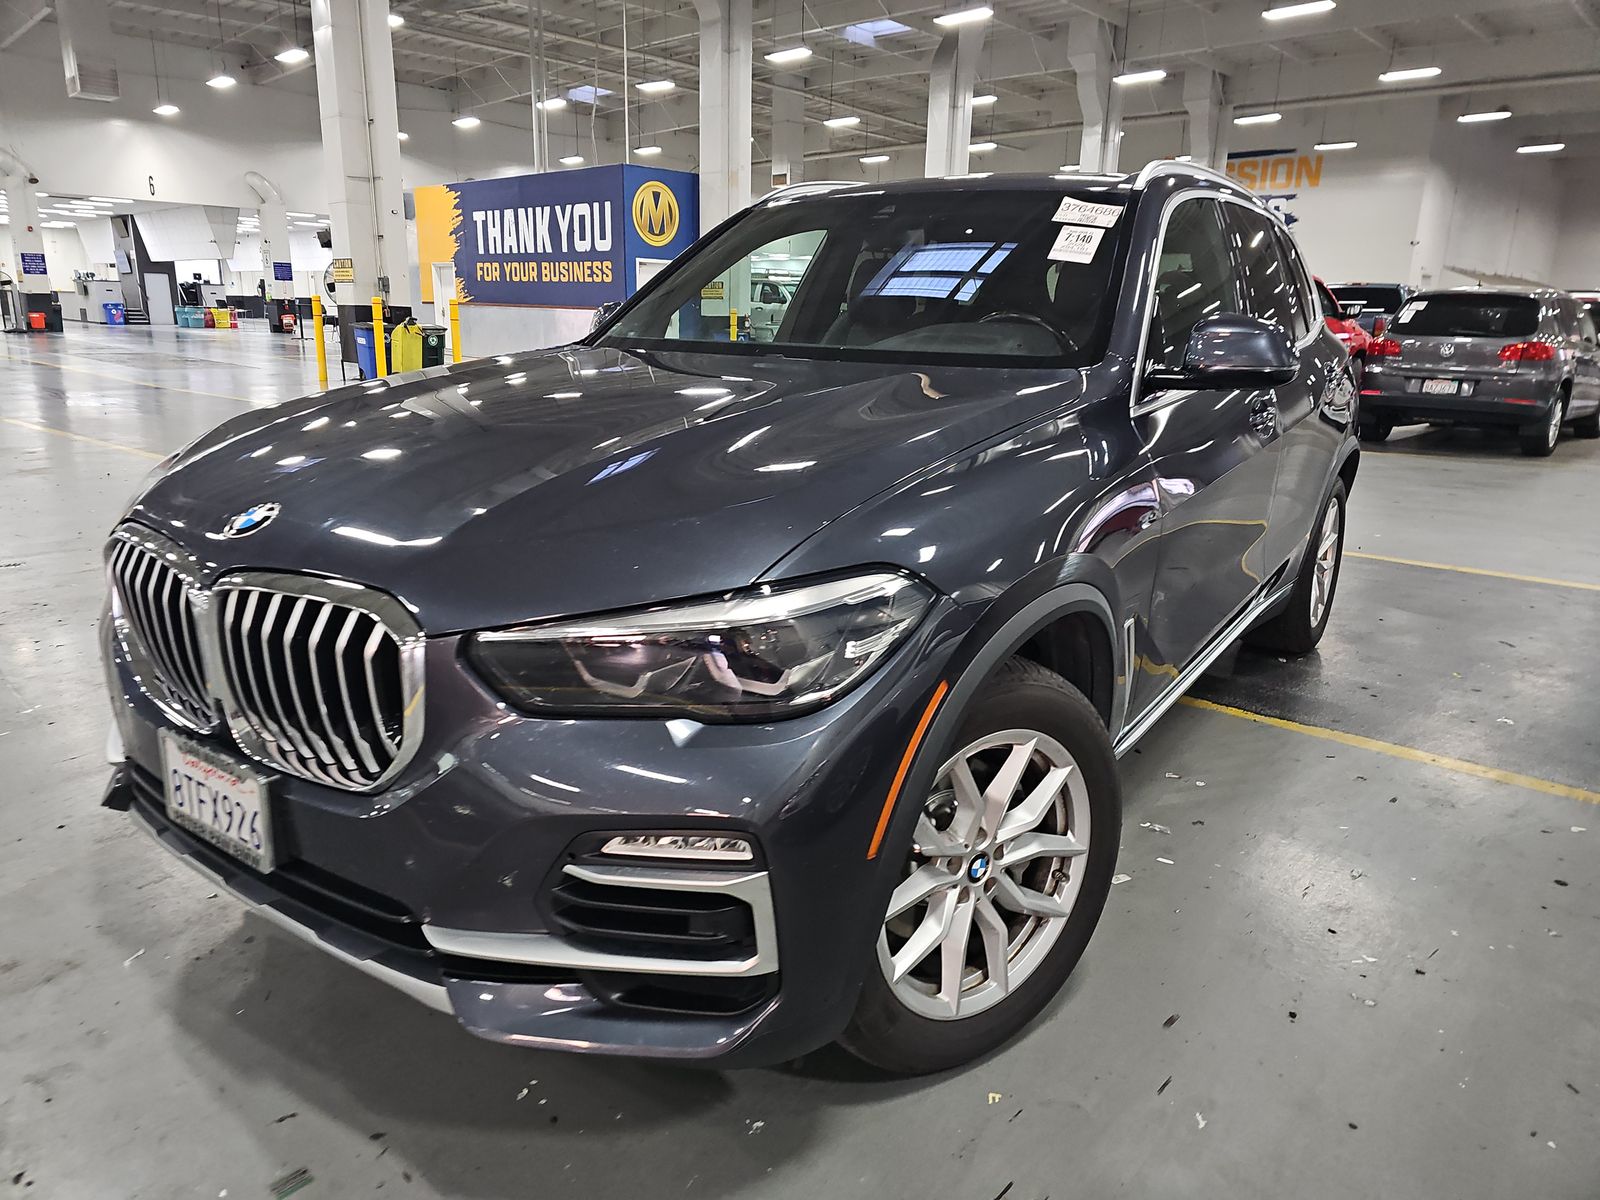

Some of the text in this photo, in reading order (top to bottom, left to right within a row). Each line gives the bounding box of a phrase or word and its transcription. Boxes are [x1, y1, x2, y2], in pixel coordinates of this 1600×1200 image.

[148, 175, 156, 196] 6
[1226, 154, 1323, 190] SION
[472, 200, 613, 255] THANK YOU
[476, 260, 613, 283] FOR YOUR BUSINESS
[171, 768, 262, 851] 8TFX926
